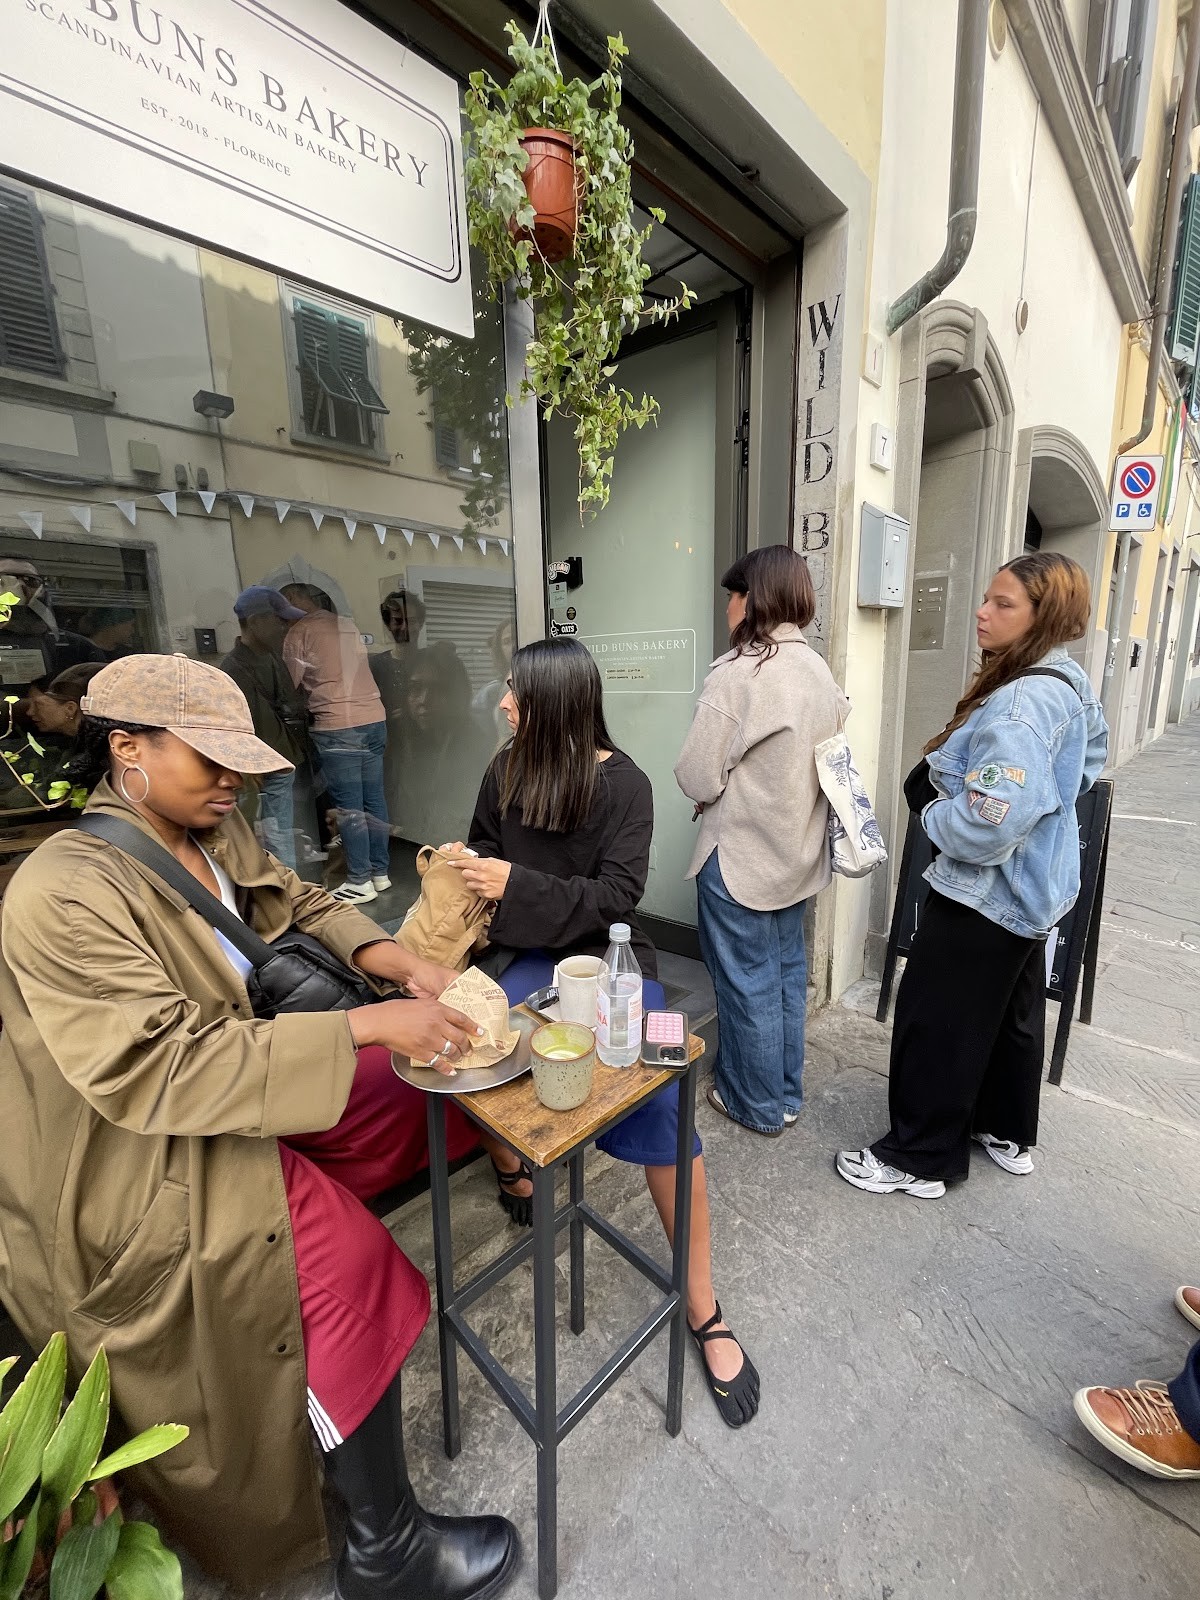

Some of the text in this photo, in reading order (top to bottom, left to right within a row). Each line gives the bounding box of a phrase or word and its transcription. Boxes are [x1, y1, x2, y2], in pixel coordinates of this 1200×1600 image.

[26, 0, 357, 173] SCANDINAVIAN ARTISAN BAKERY
[140, 97, 174, 122] EST.
[179, 115, 209, 138] 2018
[223, 136, 291, 176] FLORENCE
[259, 70, 429, 188] BAKERY
[802, 294, 841, 484] WILD
[881, 435, 888, 457] 7
[1119, 505, 1128, 516] P
[612, 642, 639, 652] BUNS
[643, 639, 688, 650] BAKERY
